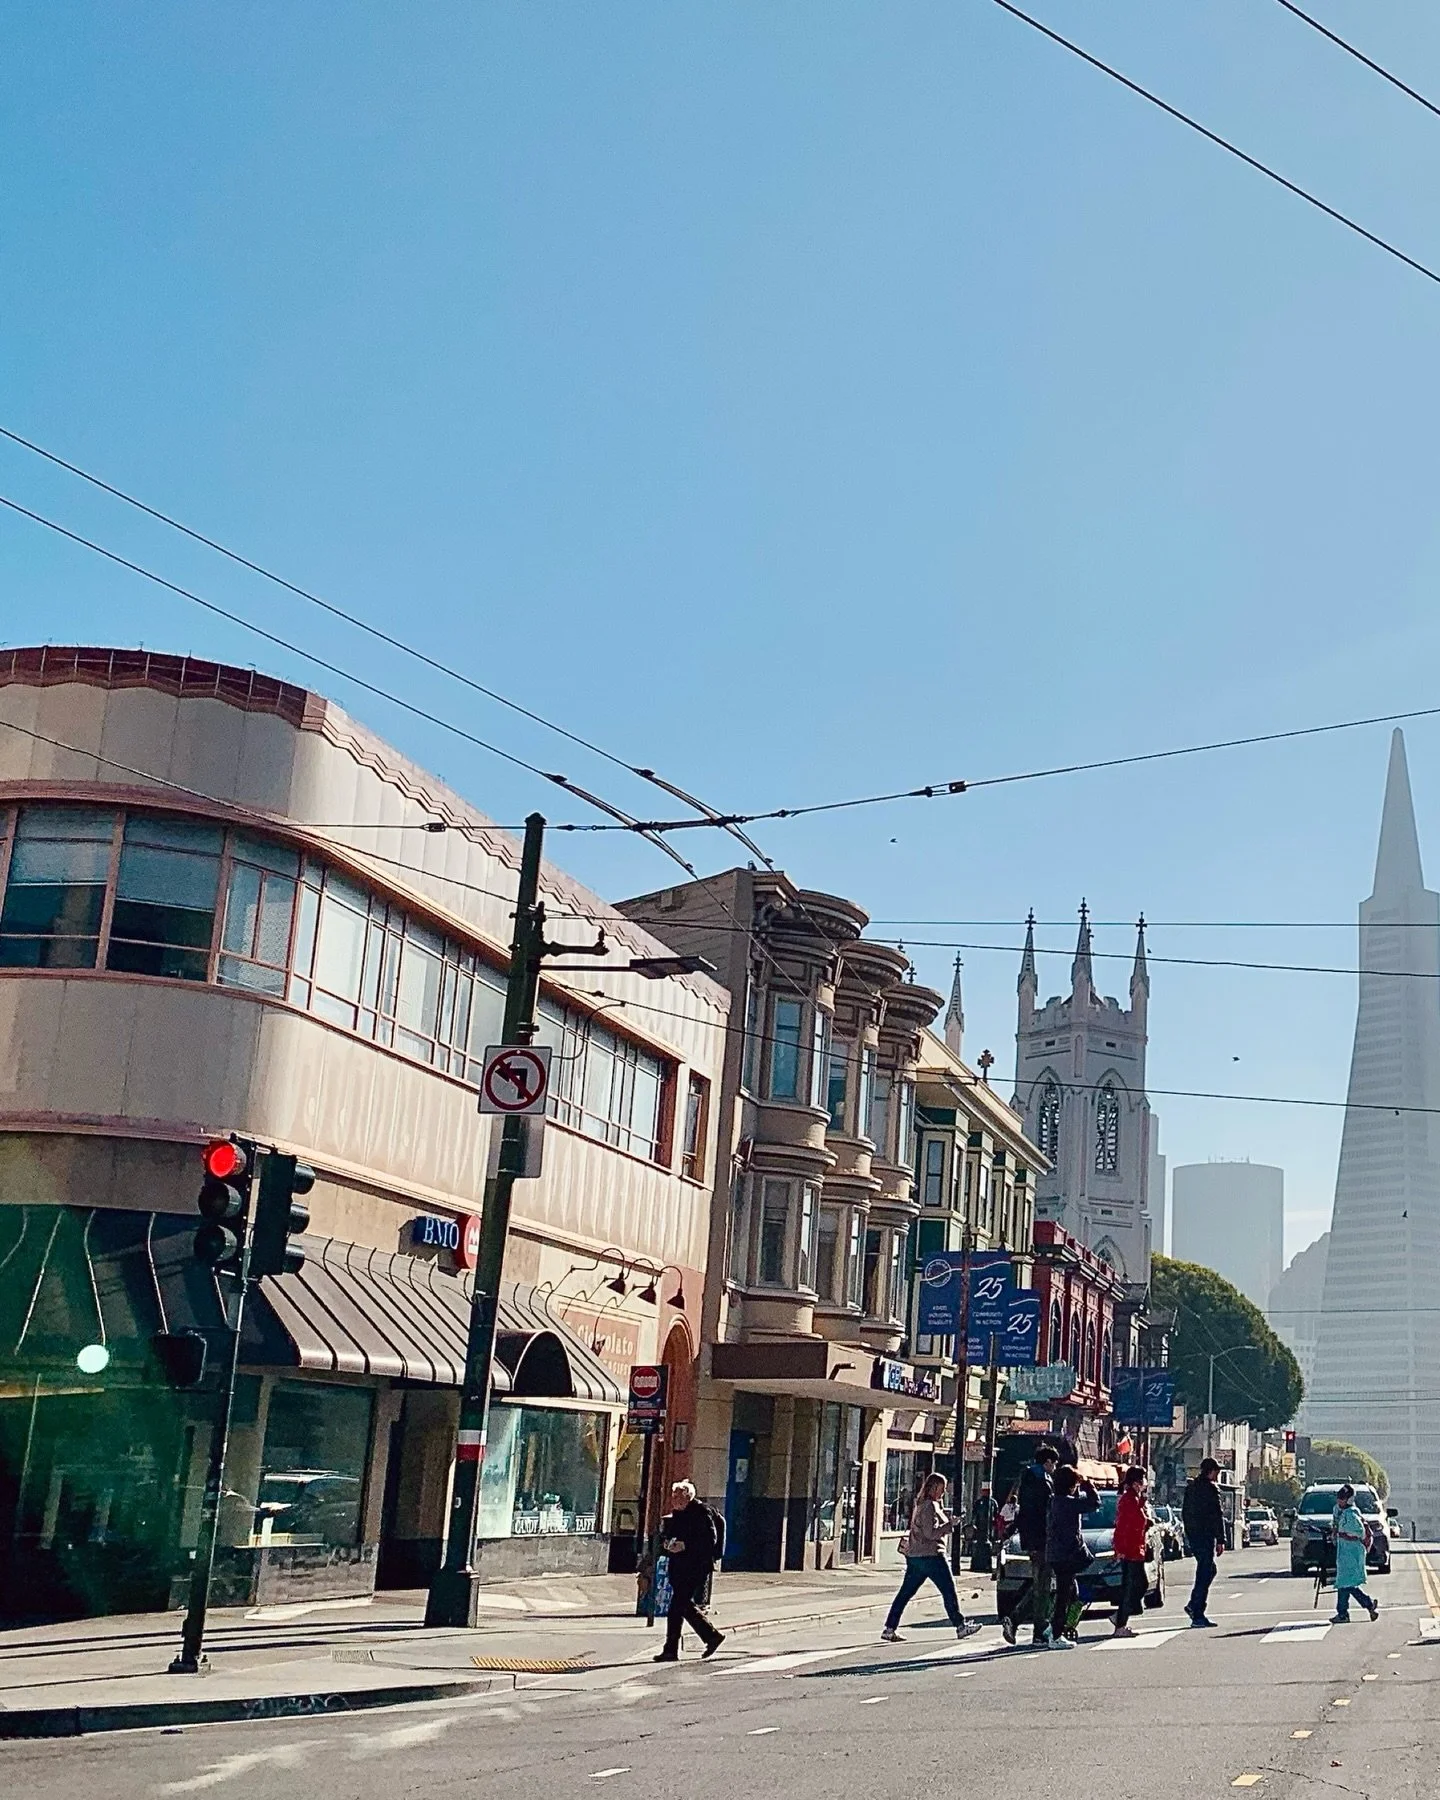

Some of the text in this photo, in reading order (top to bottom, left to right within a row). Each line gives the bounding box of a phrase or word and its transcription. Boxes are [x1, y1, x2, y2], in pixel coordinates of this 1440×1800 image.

[423, 1216, 459, 1250] BMO
[974, 1277, 1006, 1299] 25
[1007, 1313, 1035, 1334] 25
[577, 1325, 634, 1356] Cioolato
[1145, 1382, 1164, 1397] 25
[514, 1518, 539, 1534] CANDY
[575, 1518, 596, 1532] TAFFY
